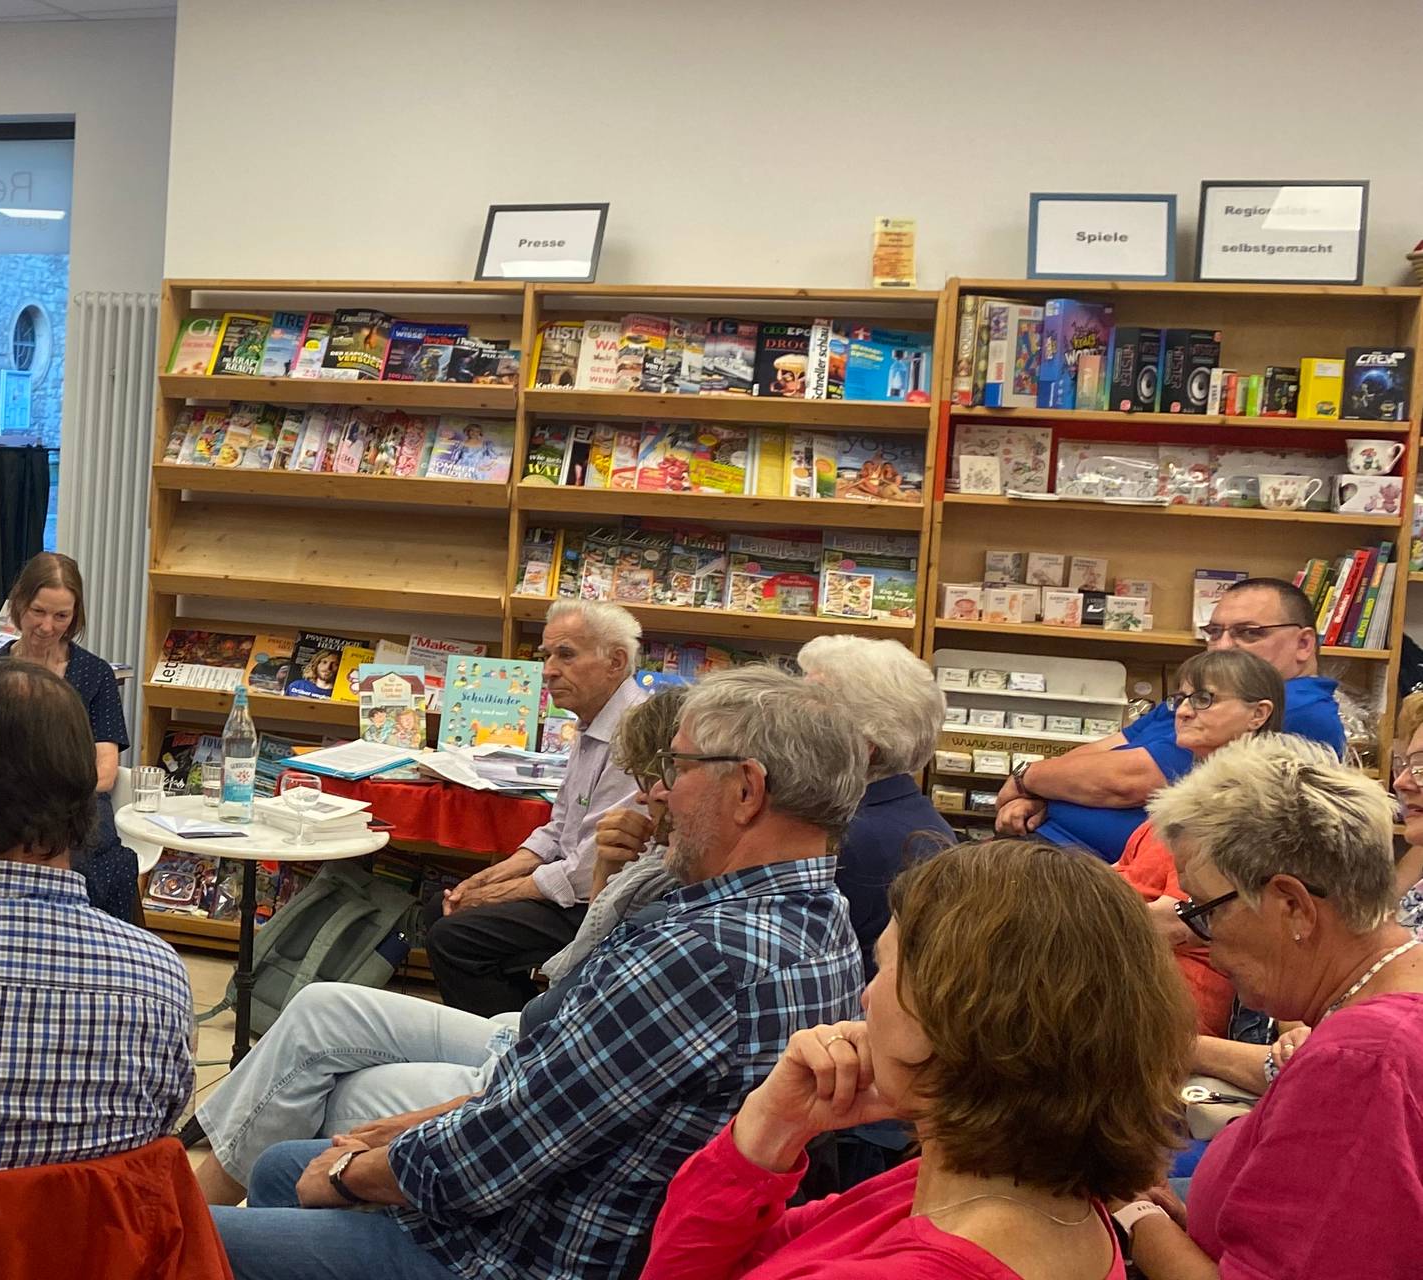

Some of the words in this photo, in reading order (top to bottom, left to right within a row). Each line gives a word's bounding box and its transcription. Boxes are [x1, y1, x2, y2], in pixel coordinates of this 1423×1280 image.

[518, 239, 566, 248] Presse
[1077, 230, 1129, 247] Spiele
[1221, 243, 1333, 255] selbstgemacht
[843, 433, 917, 461] yoga
[461, 691, 521, 705] Schulkinder
